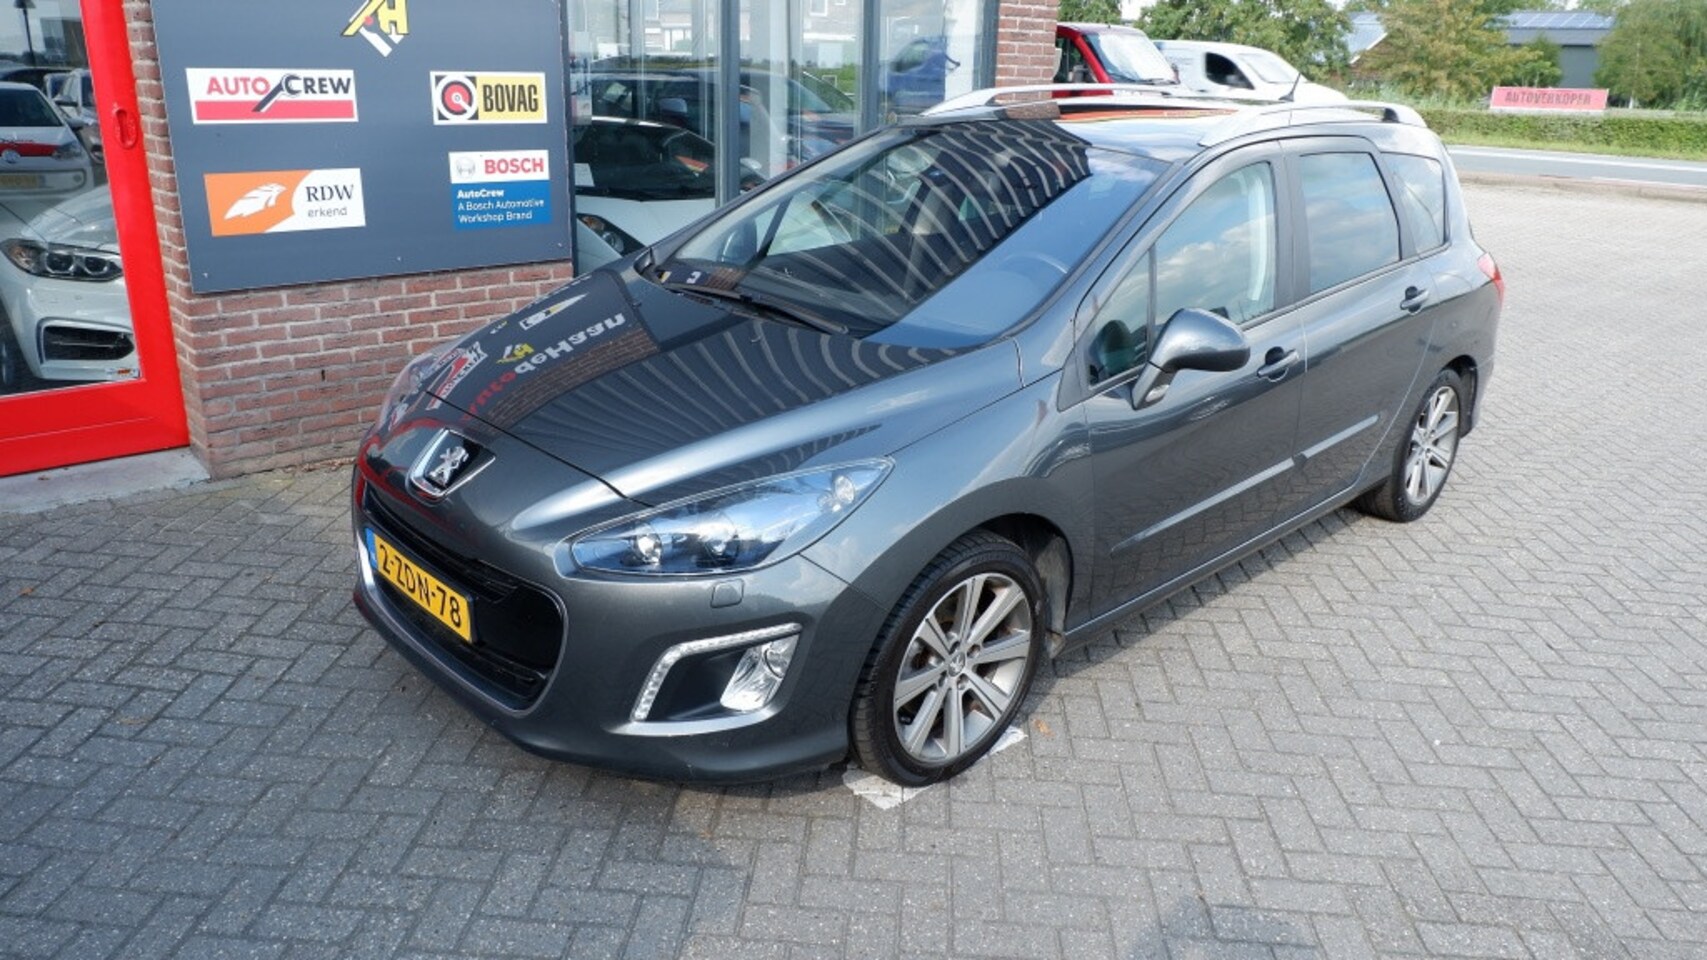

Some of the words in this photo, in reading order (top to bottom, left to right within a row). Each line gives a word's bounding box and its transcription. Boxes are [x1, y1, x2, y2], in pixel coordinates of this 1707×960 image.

[483, 84, 539, 113] BOVAG
[484, 157, 544, 174] BOSCH
[305, 184, 354, 202] RDW
[457, 188, 505, 199] AutoCrew
[458, 202, 464, 211] A
[466, 200, 494, 211] Bosch
[495, 198, 544, 209] Automotive
[307, 207, 348, 218] erkend
[458, 213, 504, 223] Workshop
[506, 210, 533, 221] Brand
[379, 543, 462, 629] 2-ZDN-78
